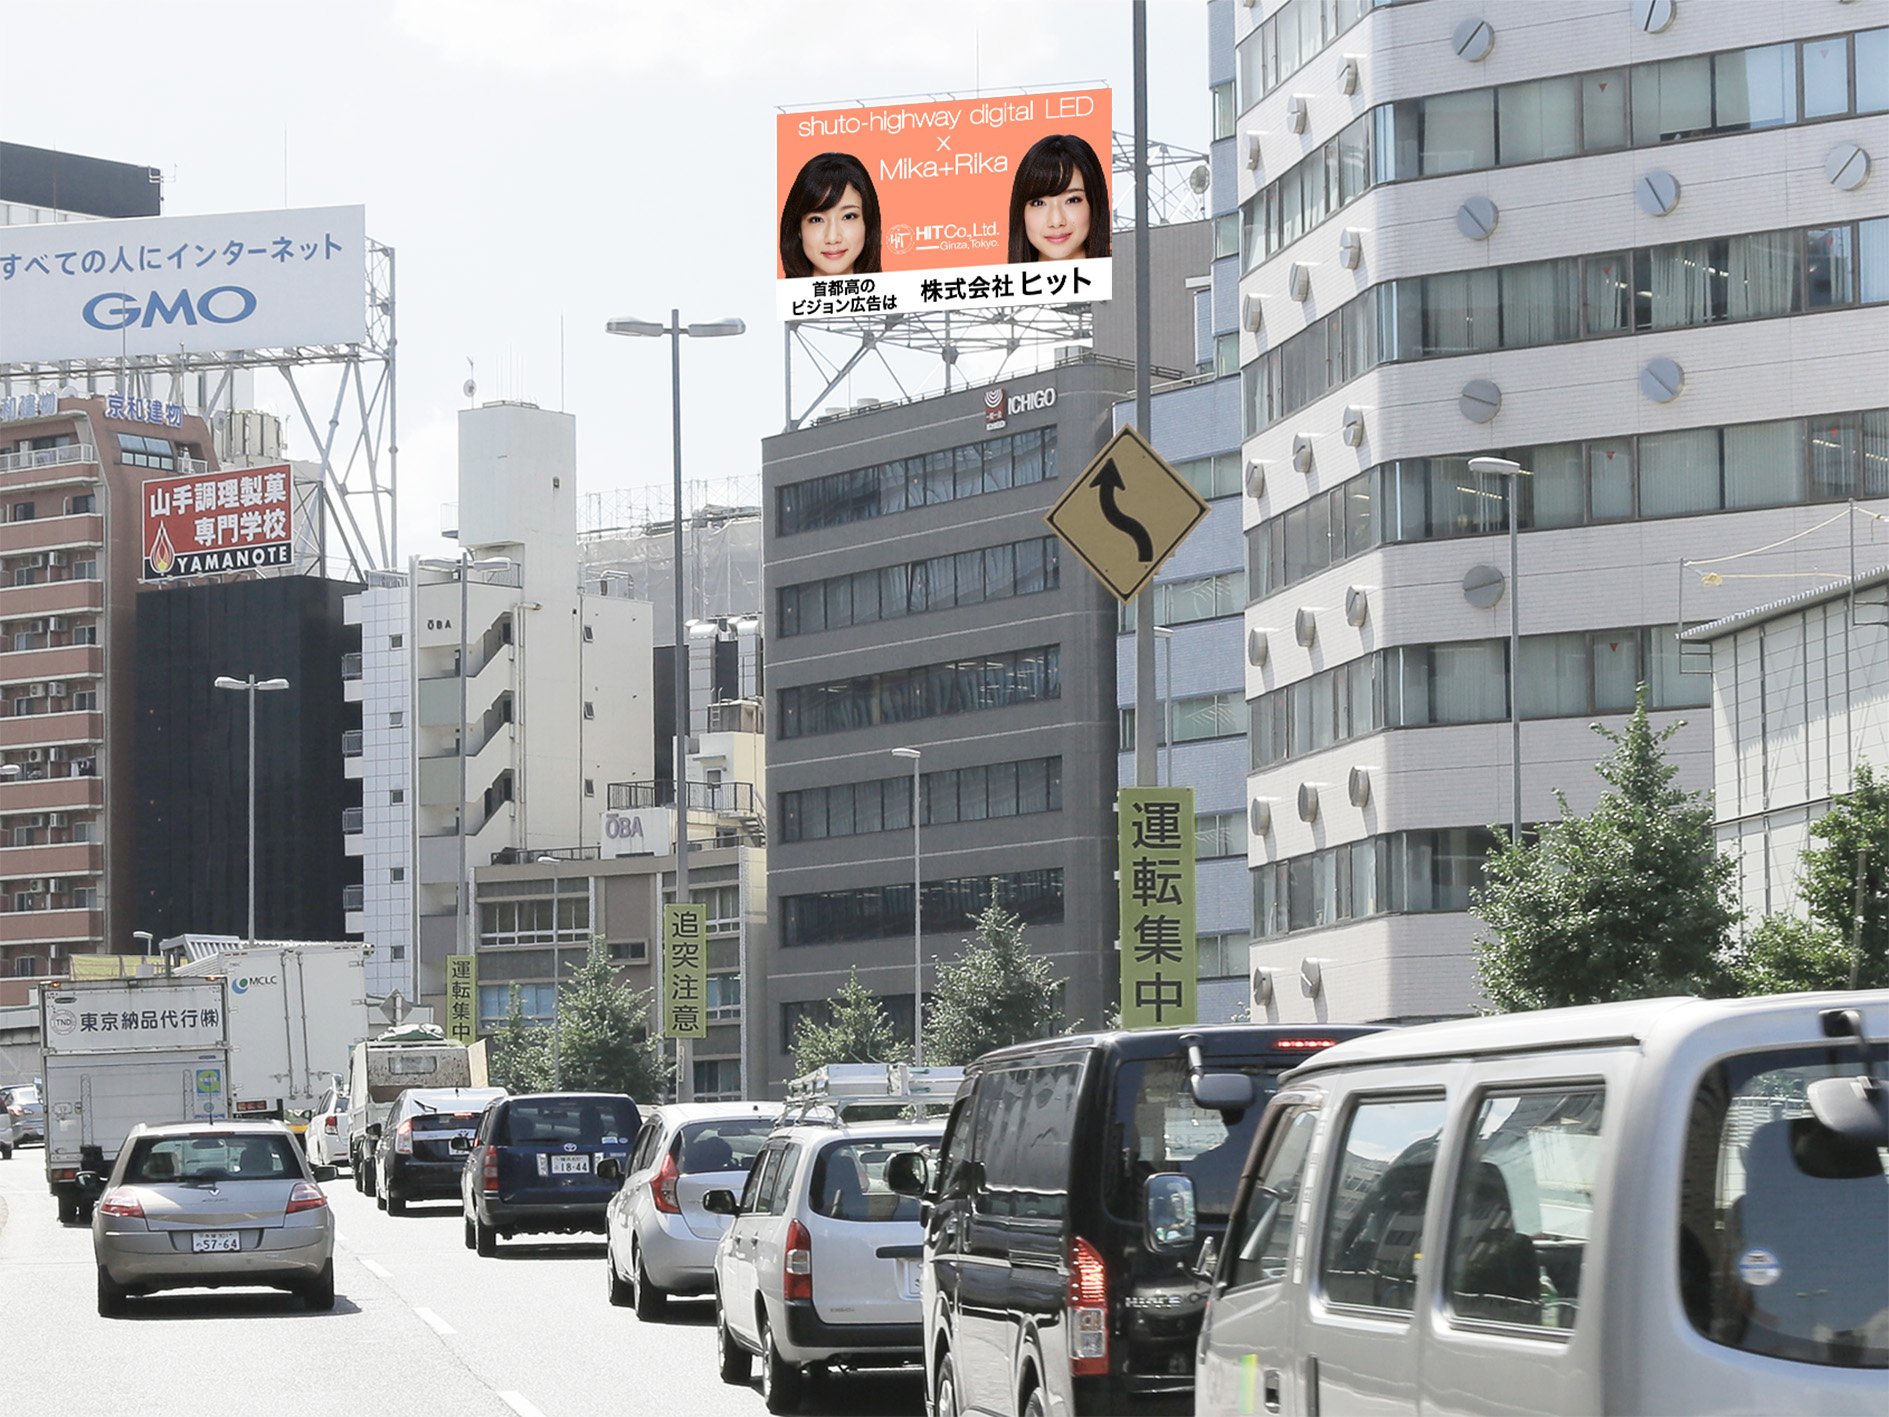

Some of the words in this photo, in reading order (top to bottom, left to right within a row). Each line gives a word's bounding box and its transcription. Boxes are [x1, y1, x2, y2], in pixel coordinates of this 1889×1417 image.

[798, 108, 962, 137] shuto-highway
[969, 99, 1034, 128] digital
[1045, 95, 1095, 119] LED
[879, 153, 1009, 181] Mika+Rika
[916, 225, 944, 240] HIT
[0, 233, 342, 280] すべての人にインターネット
[812, 278, 876, 298] 首都高の
[920, 275, 1015, 303] 株式会社
[1020, 267, 1092, 297] ヒット
[82, 286, 257, 331] GMO
[792, 294, 898, 316] ビジョン広告は
[1007, 387, 1056, 415] ICHIGO
[150, 472, 286, 518] 山手調理製菓
[194, 508, 286, 547] 専門学校
[177, 546, 287, 573] YAMANOTE
[1131, 801, 1183, 1023] 運転集中
[249, 975, 278, 986] MCLC
[672, 911, 699, 1031] 追突注意
[452, 960, 471, 1041] 運転集中
[56, 1019, 72, 1027] TND
